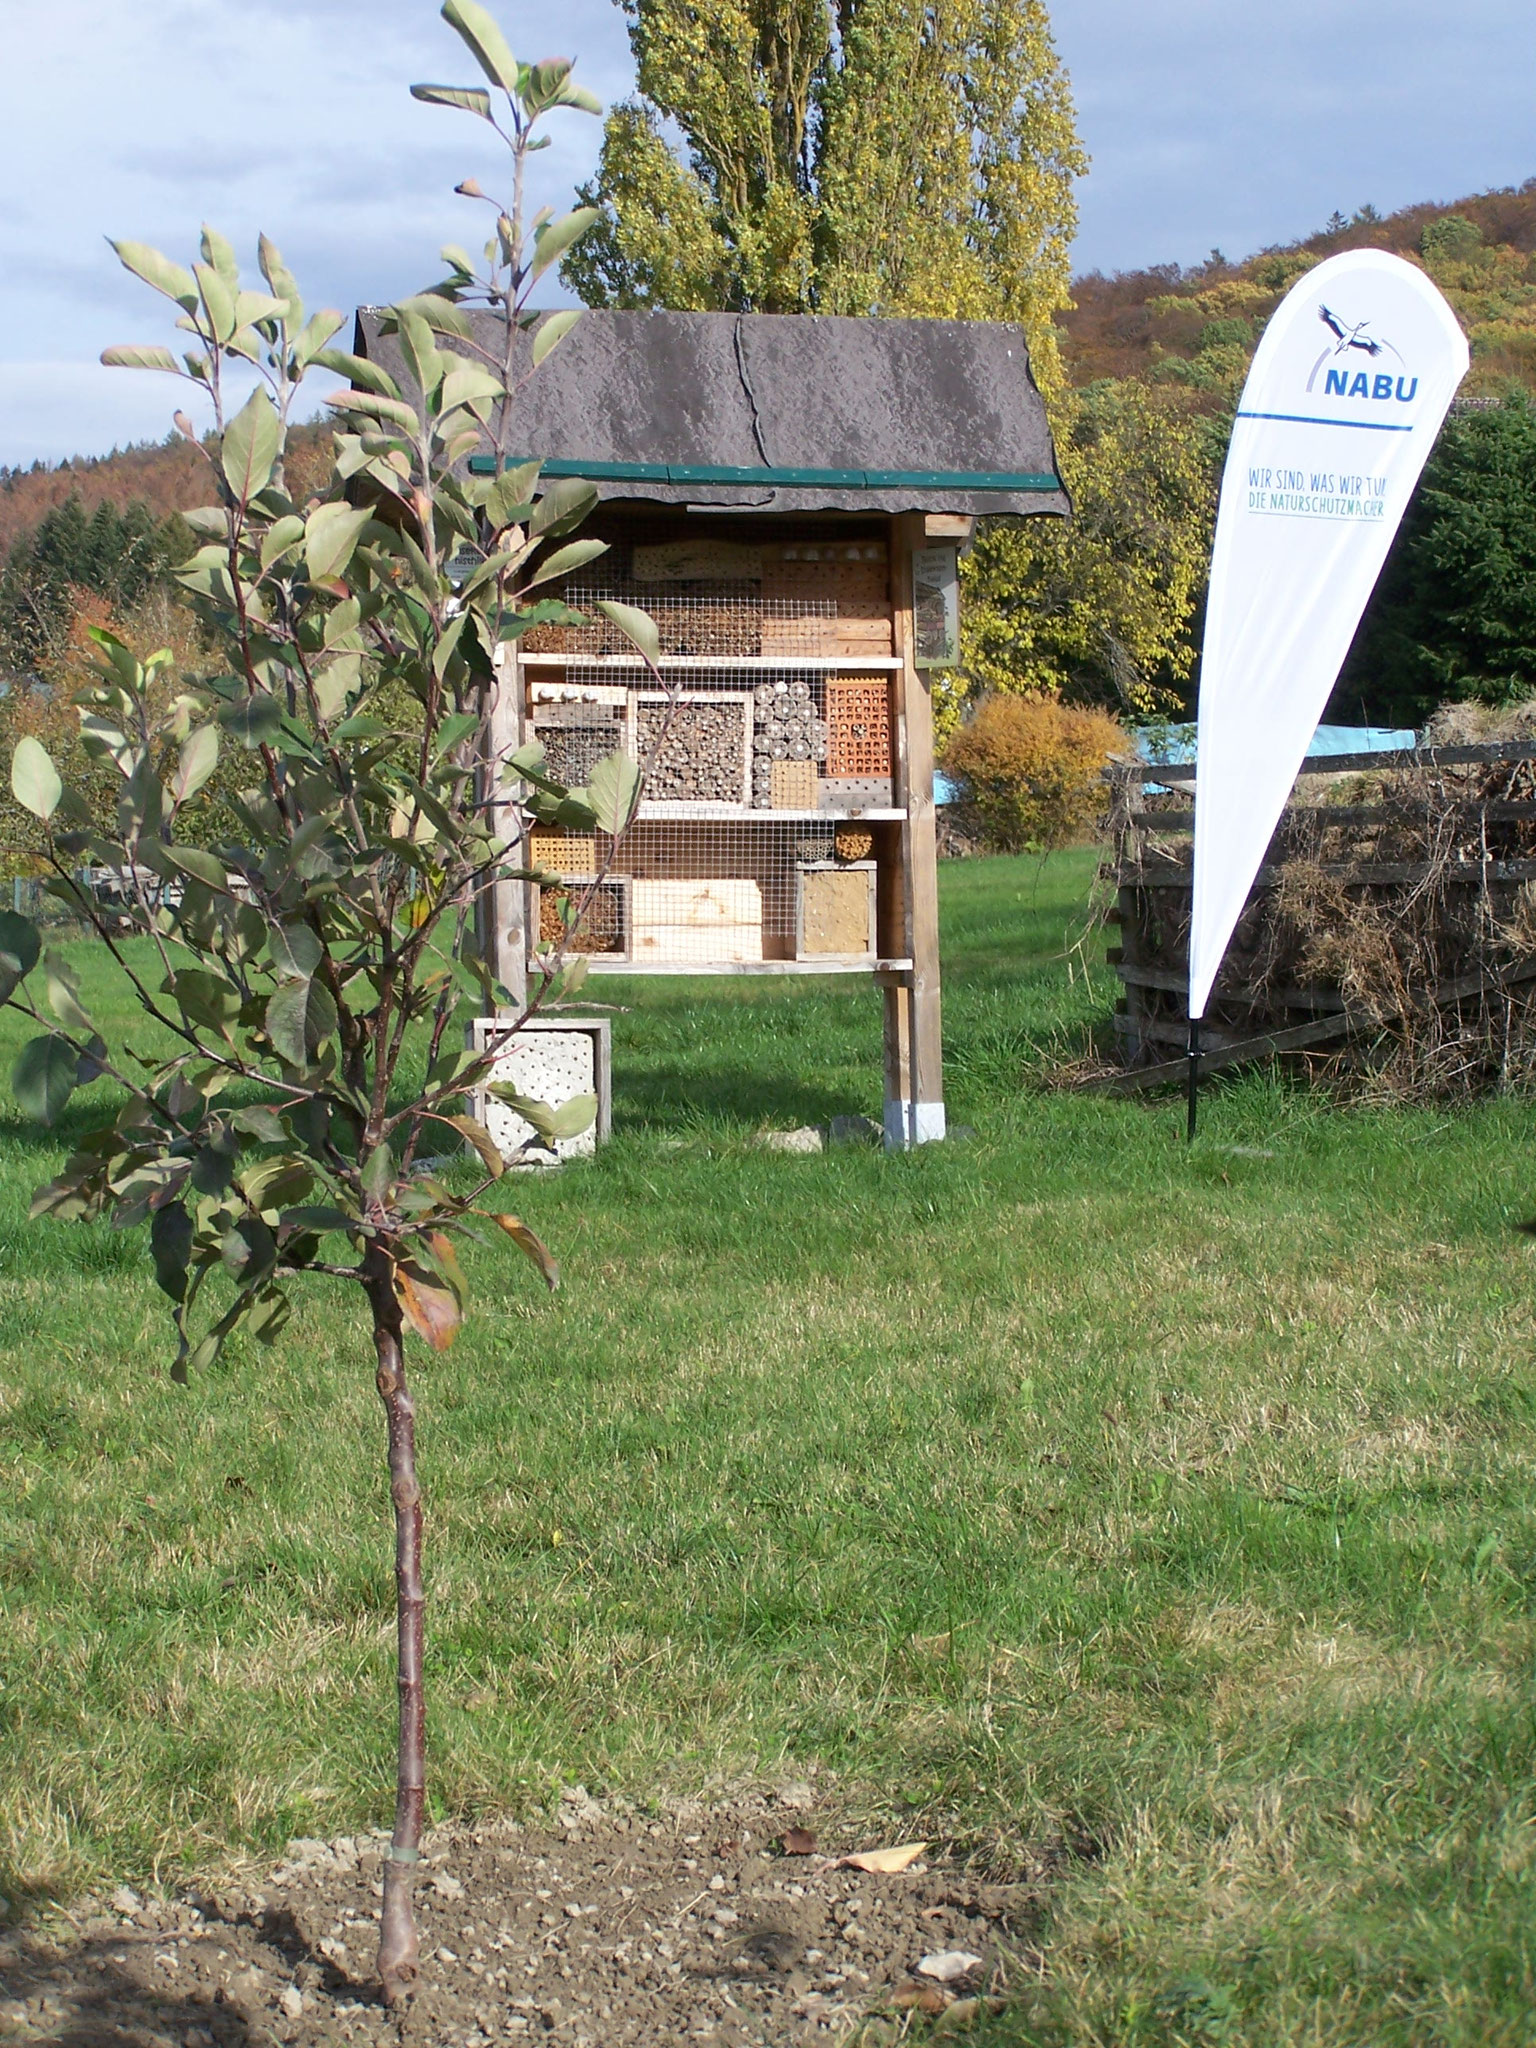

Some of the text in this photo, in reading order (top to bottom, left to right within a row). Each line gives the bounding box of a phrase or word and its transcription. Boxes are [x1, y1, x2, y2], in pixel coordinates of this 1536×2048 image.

[1324, 369, 1418, 402] NABU
[1249, 467, 1272, 488] WIR
[1310, 473, 1334, 493] WAS
[1339, 475, 1362, 495] WIR
[1249, 491, 1266, 509] DIE
